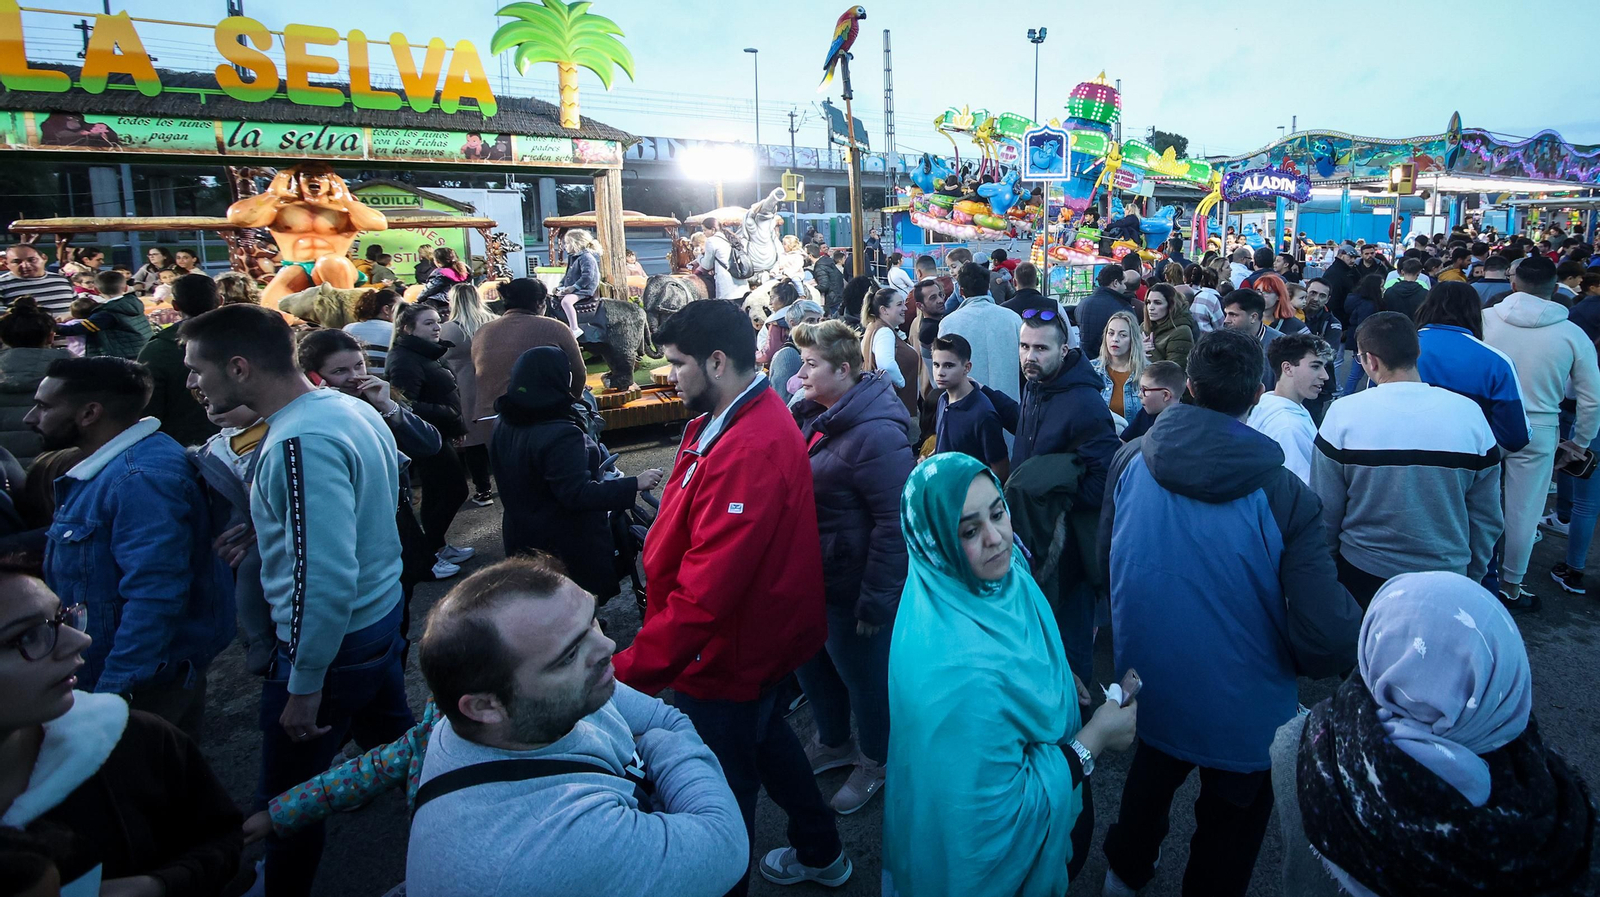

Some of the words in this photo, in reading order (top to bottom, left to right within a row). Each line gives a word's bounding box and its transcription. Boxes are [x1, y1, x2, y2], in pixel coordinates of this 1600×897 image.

[0, 0, 163, 97] LA
[214, 15, 498, 117] SELVA
[117, 115, 151, 126] todos
[155, 117, 174, 127] los
[148, 131, 189, 143] pagan
[227, 121, 264, 149] la
[279, 125, 362, 151] selva
[372, 128, 400, 137] todos
[403, 129, 419, 138] los
[373, 138, 390, 146] con
[395, 137, 411, 146] las
[415, 138, 449, 148] Fichas
[391, 146, 408, 155] las
[411, 148, 445, 156] manos
[530, 144, 561, 153] padres
[1241, 176, 1297, 193] ALADIN
[360, 196, 420, 206] AQUILLA
[1364, 197, 1395, 206] Taquilla
